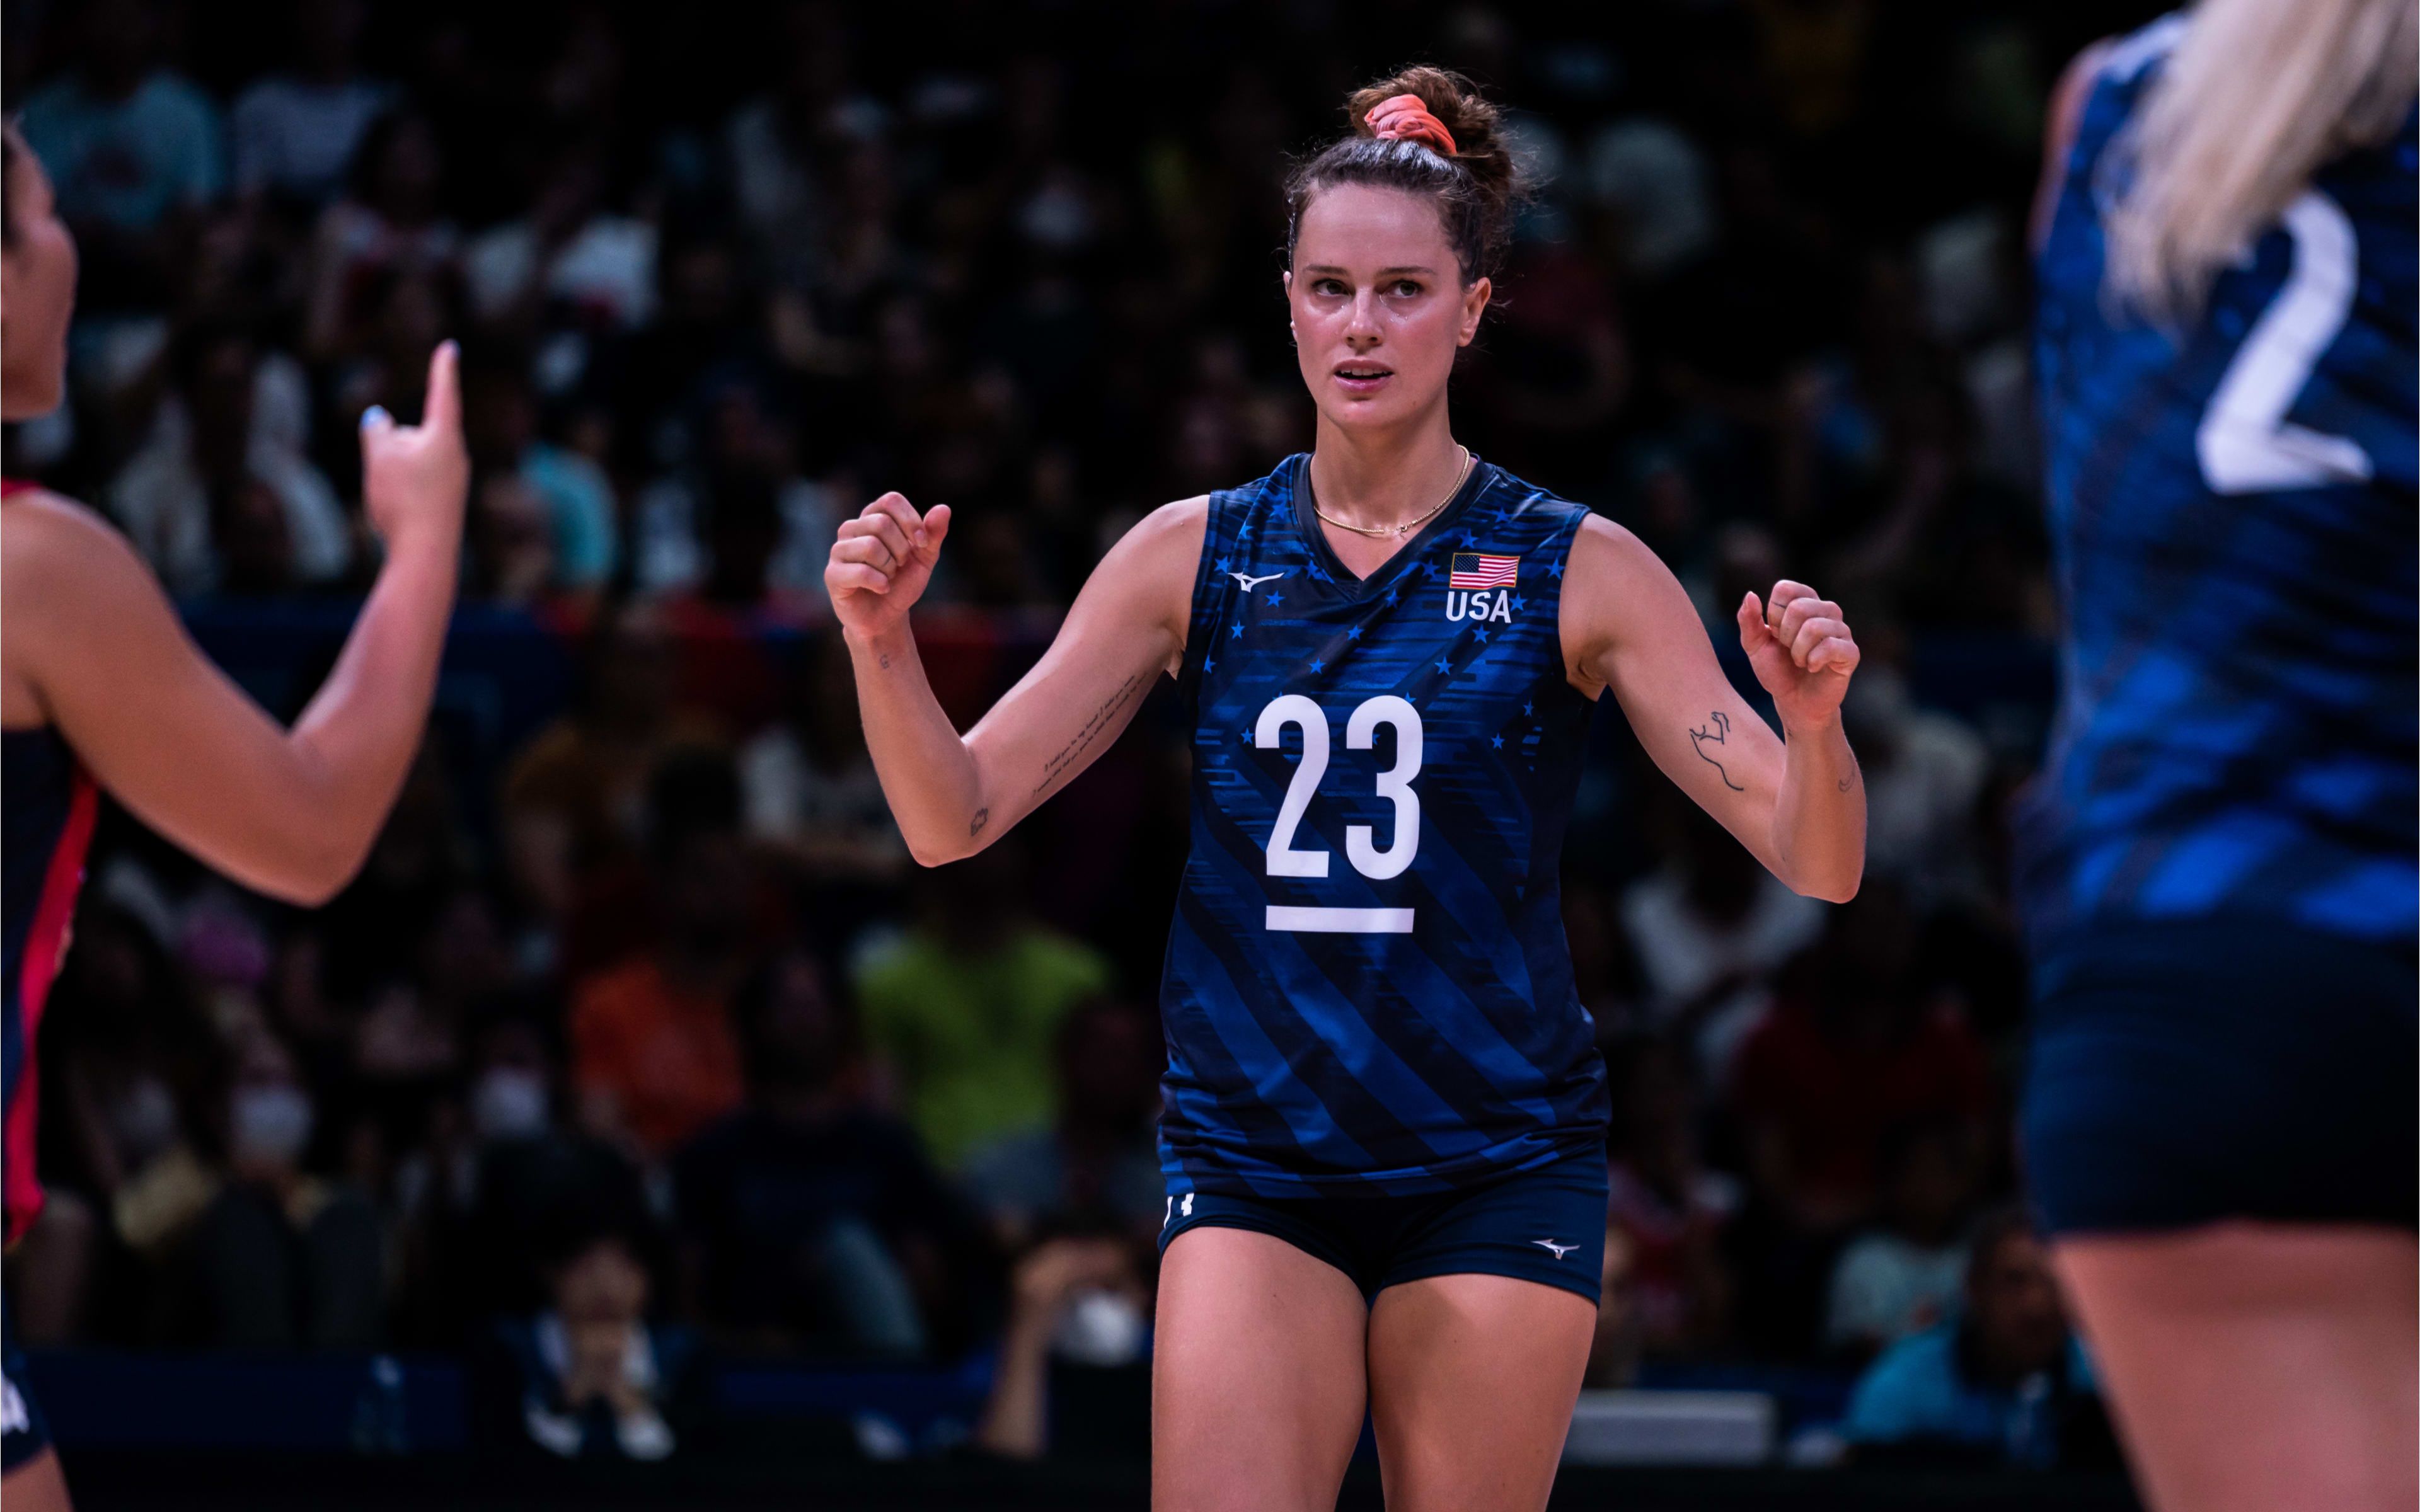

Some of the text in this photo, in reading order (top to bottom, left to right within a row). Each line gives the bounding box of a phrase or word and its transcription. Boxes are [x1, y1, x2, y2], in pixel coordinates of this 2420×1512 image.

[2196, 192, 2373, 493] 2
[1446, 590, 1511, 623] USA
[1255, 694, 1423, 880] 23
